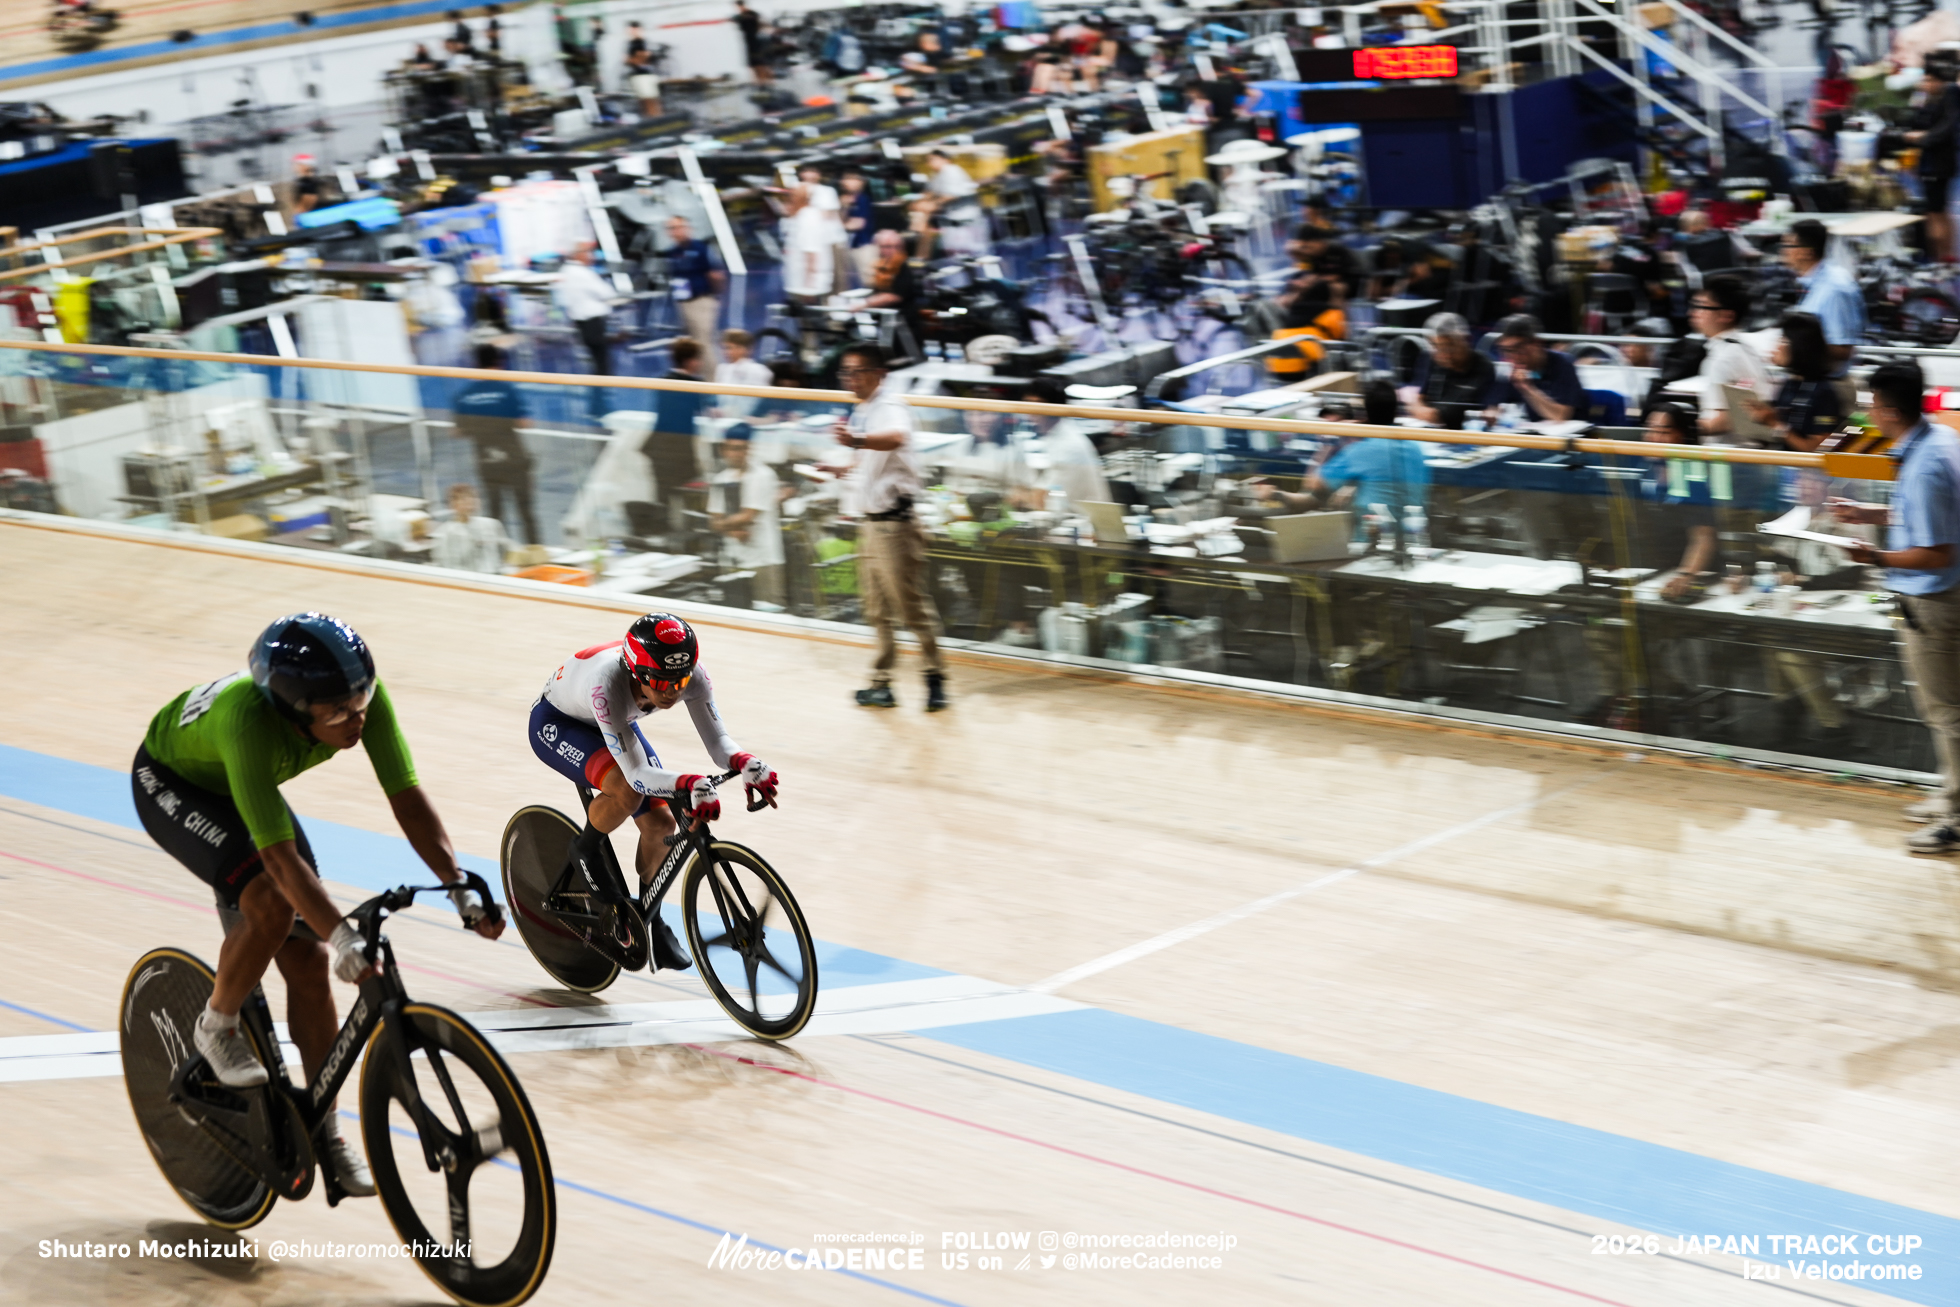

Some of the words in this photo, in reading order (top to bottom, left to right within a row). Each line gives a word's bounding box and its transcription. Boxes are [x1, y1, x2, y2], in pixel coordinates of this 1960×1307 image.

[555, 740, 585, 762] SPEED
[136, 765, 165, 796] HONG
[183, 810, 229, 848] CHINA
[312, 1020, 357, 1109] ARGON
